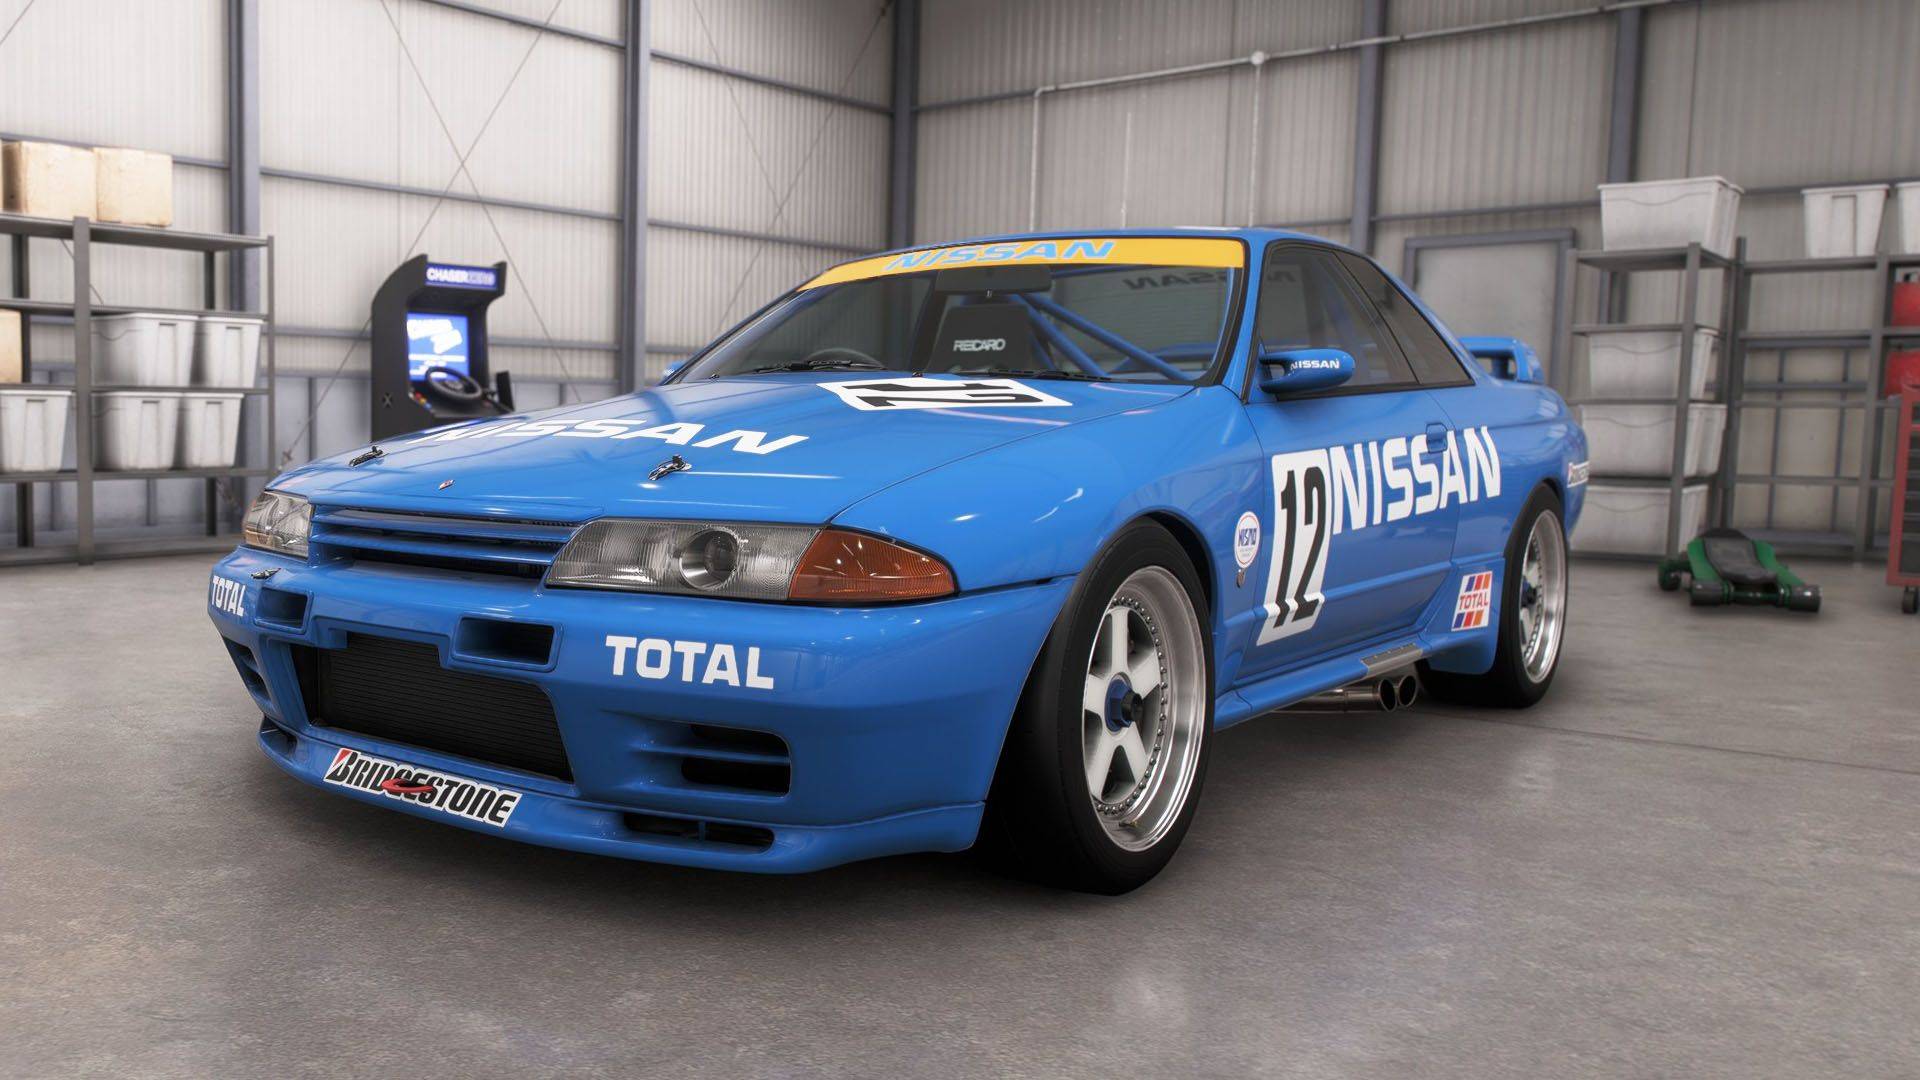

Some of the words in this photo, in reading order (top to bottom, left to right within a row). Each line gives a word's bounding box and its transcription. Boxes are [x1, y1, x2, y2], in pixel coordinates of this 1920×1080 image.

[884, 241, 1115, 271] NISSAN
[953, 338, 1006, 351] RECARO
[1290, 359, 1340, 370] NISSAN
[406, 419, 809, 455] NISSAN
[1332, 425, 1501, 535] NISSAN
[1273, 465, 1327, 629] 12
[211, 575, 246, 617] TOTAL
[1459, 592, 1489, 610] TOTAL
[605, 635, 774, 690] TOTAL
